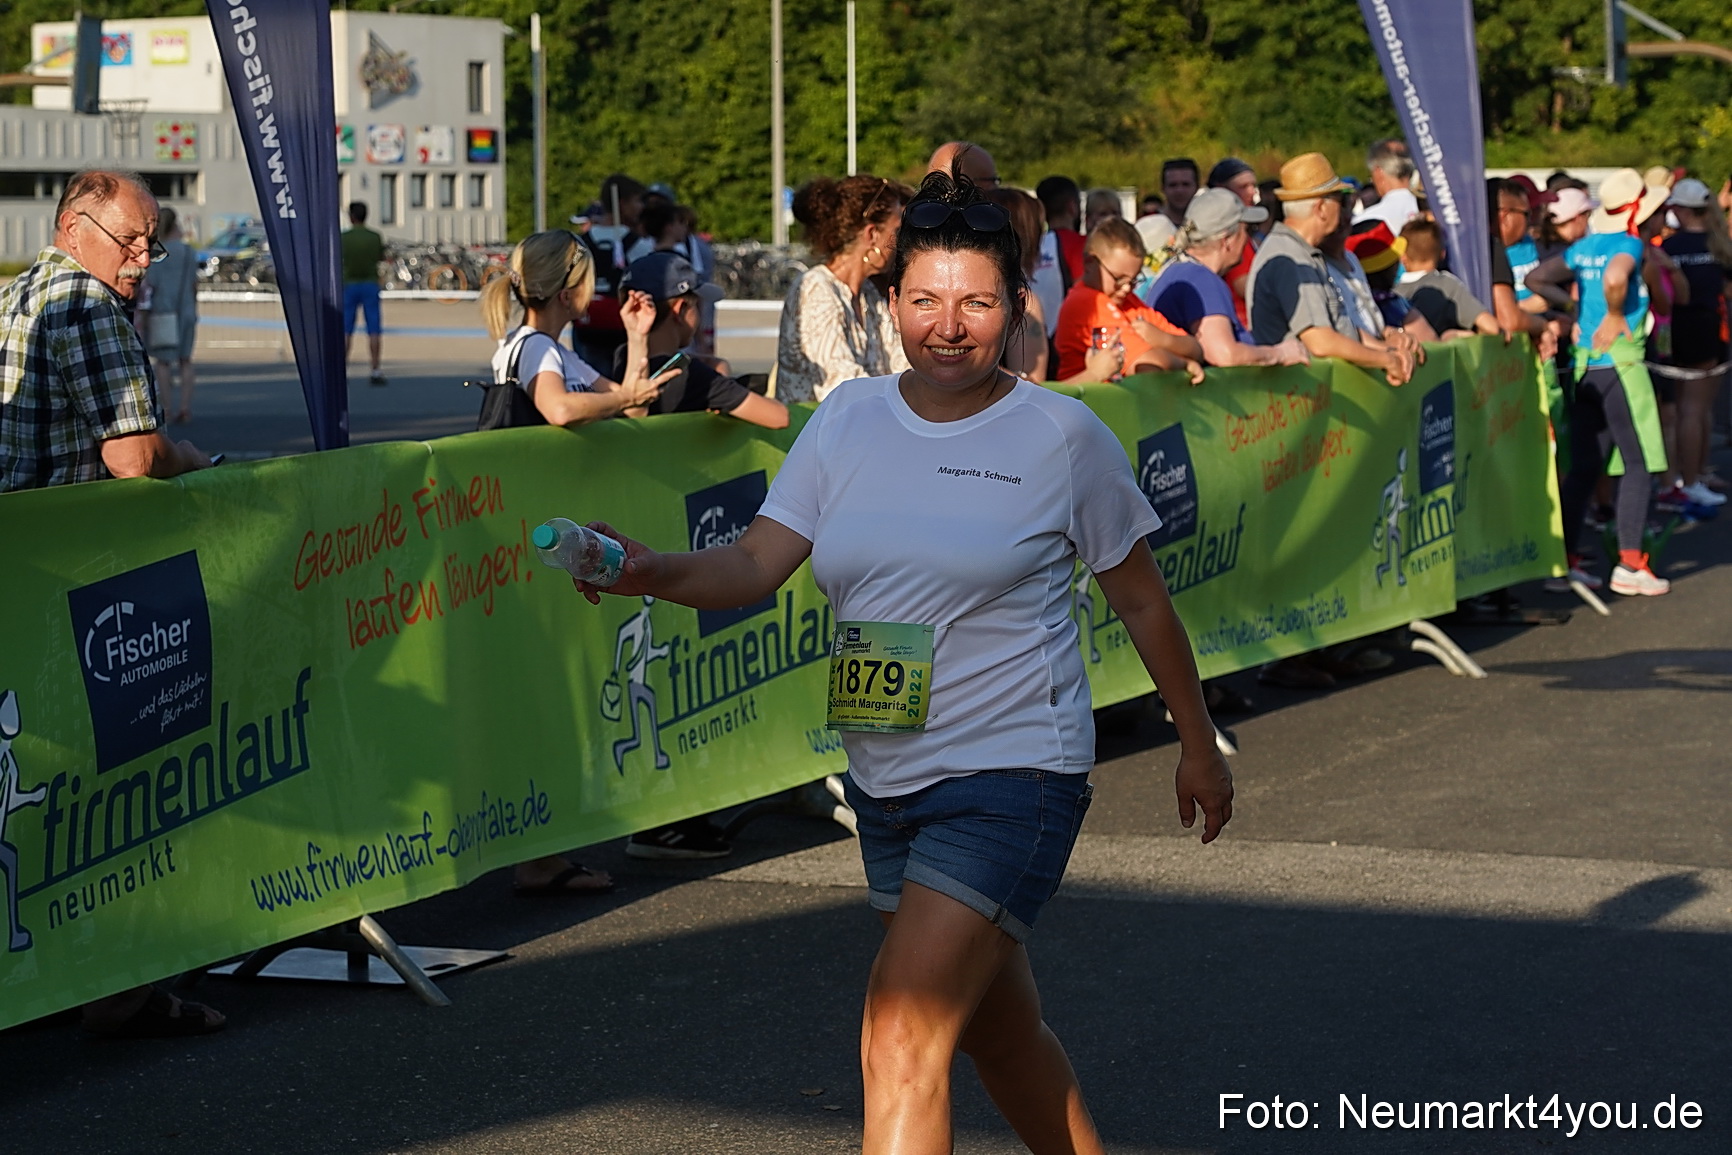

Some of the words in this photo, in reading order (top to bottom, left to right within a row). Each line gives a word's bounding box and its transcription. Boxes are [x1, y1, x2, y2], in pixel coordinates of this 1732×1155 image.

[937, 466, 981, 477] Margarita
[984, 470, 1022, 486] Schmidt
[1150, 464, 1187, 494] Fischer
[294, 488, 408, 591] Gesunde
[412, 475, 504, 539] Firmen
[346, 567, 444, 650] laufen
[444, 519, 533, 616] länger!
[105, 618, 191, 671] Fischer
[120, 649, 188, 687] AUTOMOBILE
[837, 659, 905, 696] 1879
[907, 669, 923, 718] 2022
[677, 694, 757, 755] neumarkt
[832, 698, 857, 708] Schmidt
[858, 698, 907, 711] Margarita
[43, 666, 311, 884] firmenlauf
[49, 840, 176, 929] neumarkt
